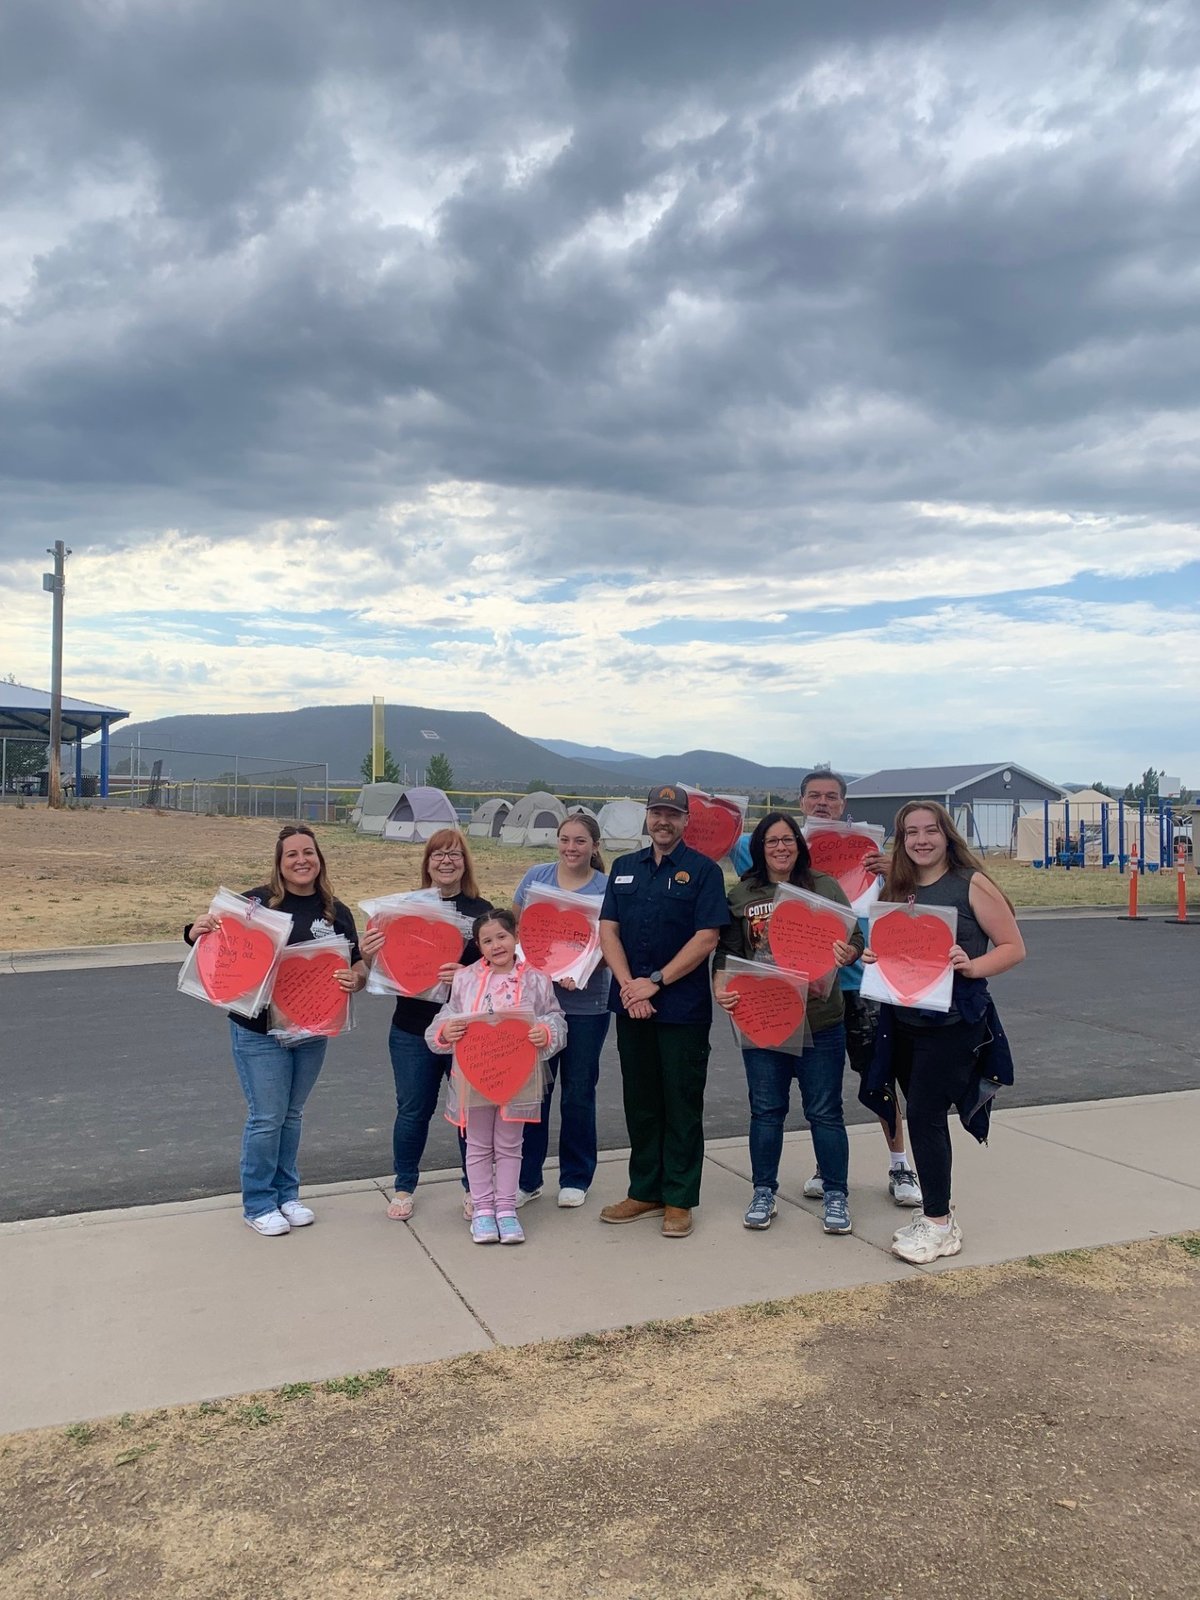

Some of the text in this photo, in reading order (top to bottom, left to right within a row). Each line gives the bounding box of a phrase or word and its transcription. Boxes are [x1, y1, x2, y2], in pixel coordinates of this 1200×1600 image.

[819, 840, 842, 852] GOD
[815, 855, 832, 864] OUR
[748, 903, 774, 917] COTTO
